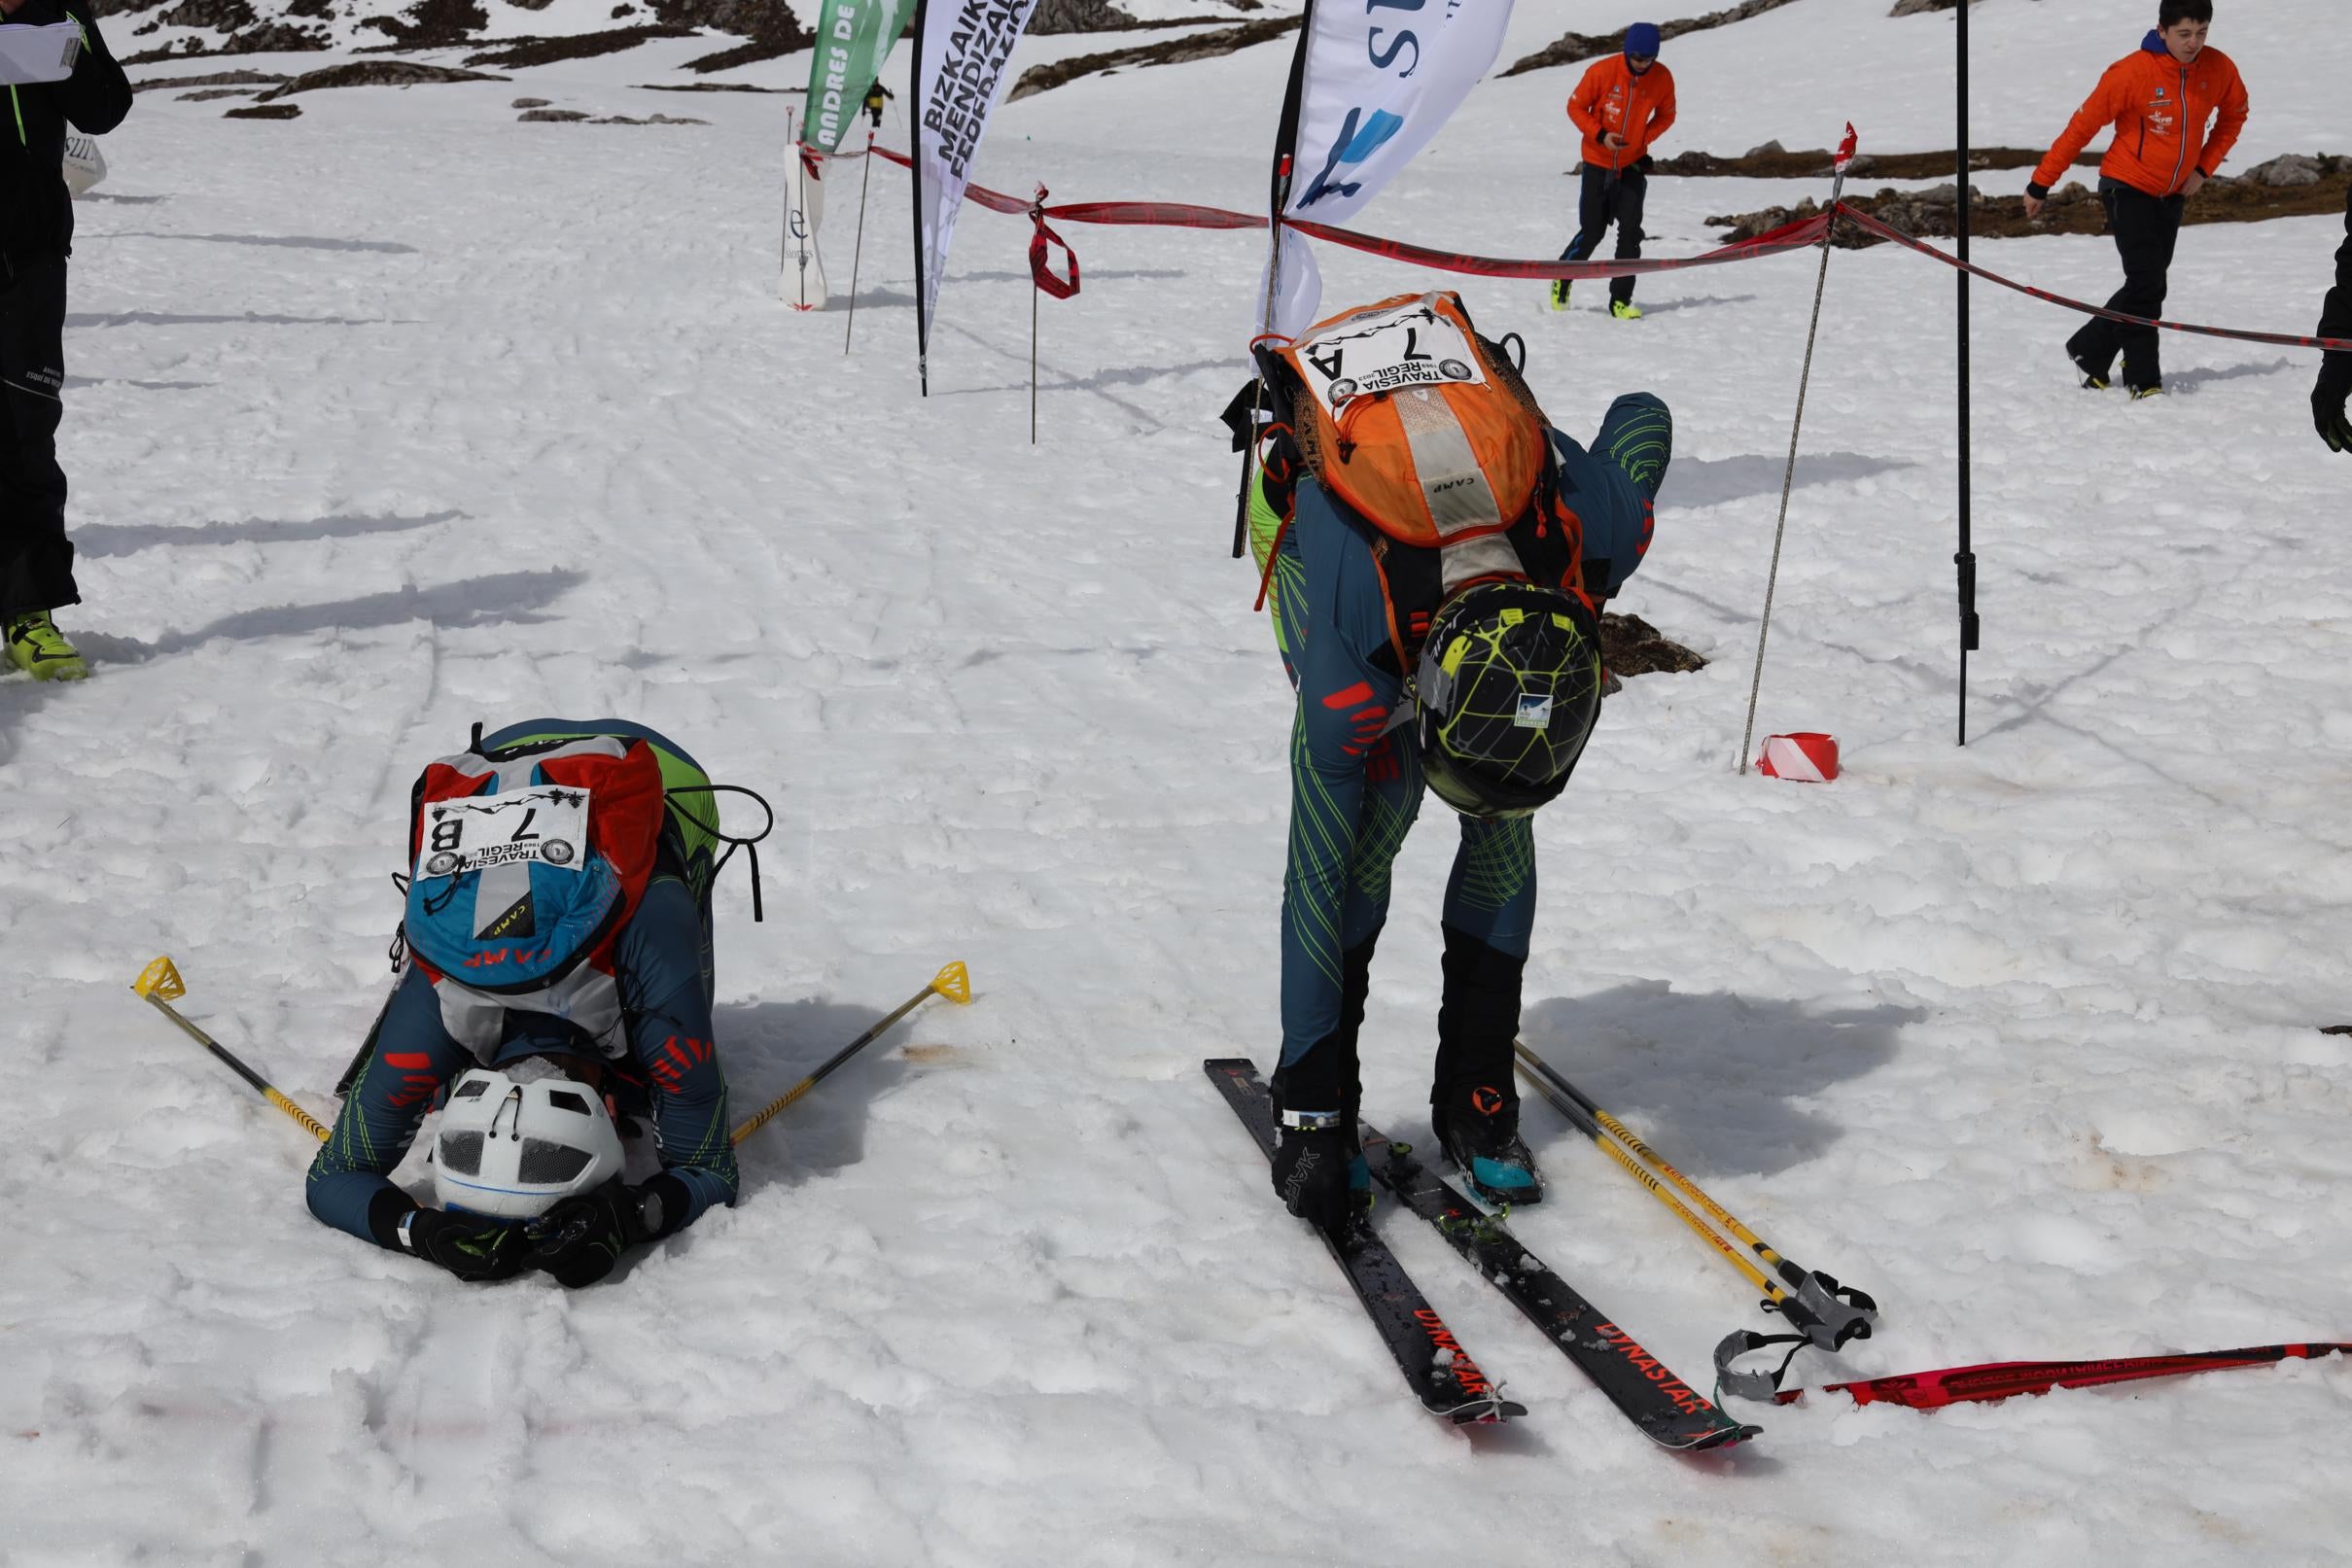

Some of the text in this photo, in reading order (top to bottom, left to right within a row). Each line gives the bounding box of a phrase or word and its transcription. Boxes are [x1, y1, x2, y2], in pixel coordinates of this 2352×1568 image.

[833, 4, 856, 41] DE
[1404, 328, 1432, 361] 7
[1309, 348, 1343, 381] A
[1373, 362, 1422, 376] REGIL
[1363, 371, 1443, 390] TRAVESIA
[1433, 477, 1475, 494] CAMP
[431, 819, 463, 853] B
[510, 808, 540, 842] 7
[463, 849, 540, 870] TRAVESIA
[478, 842, 523, 857] REGIL
[493, 905, 526, 936] CAMP
[462, 948, 552, 968] CAMP
